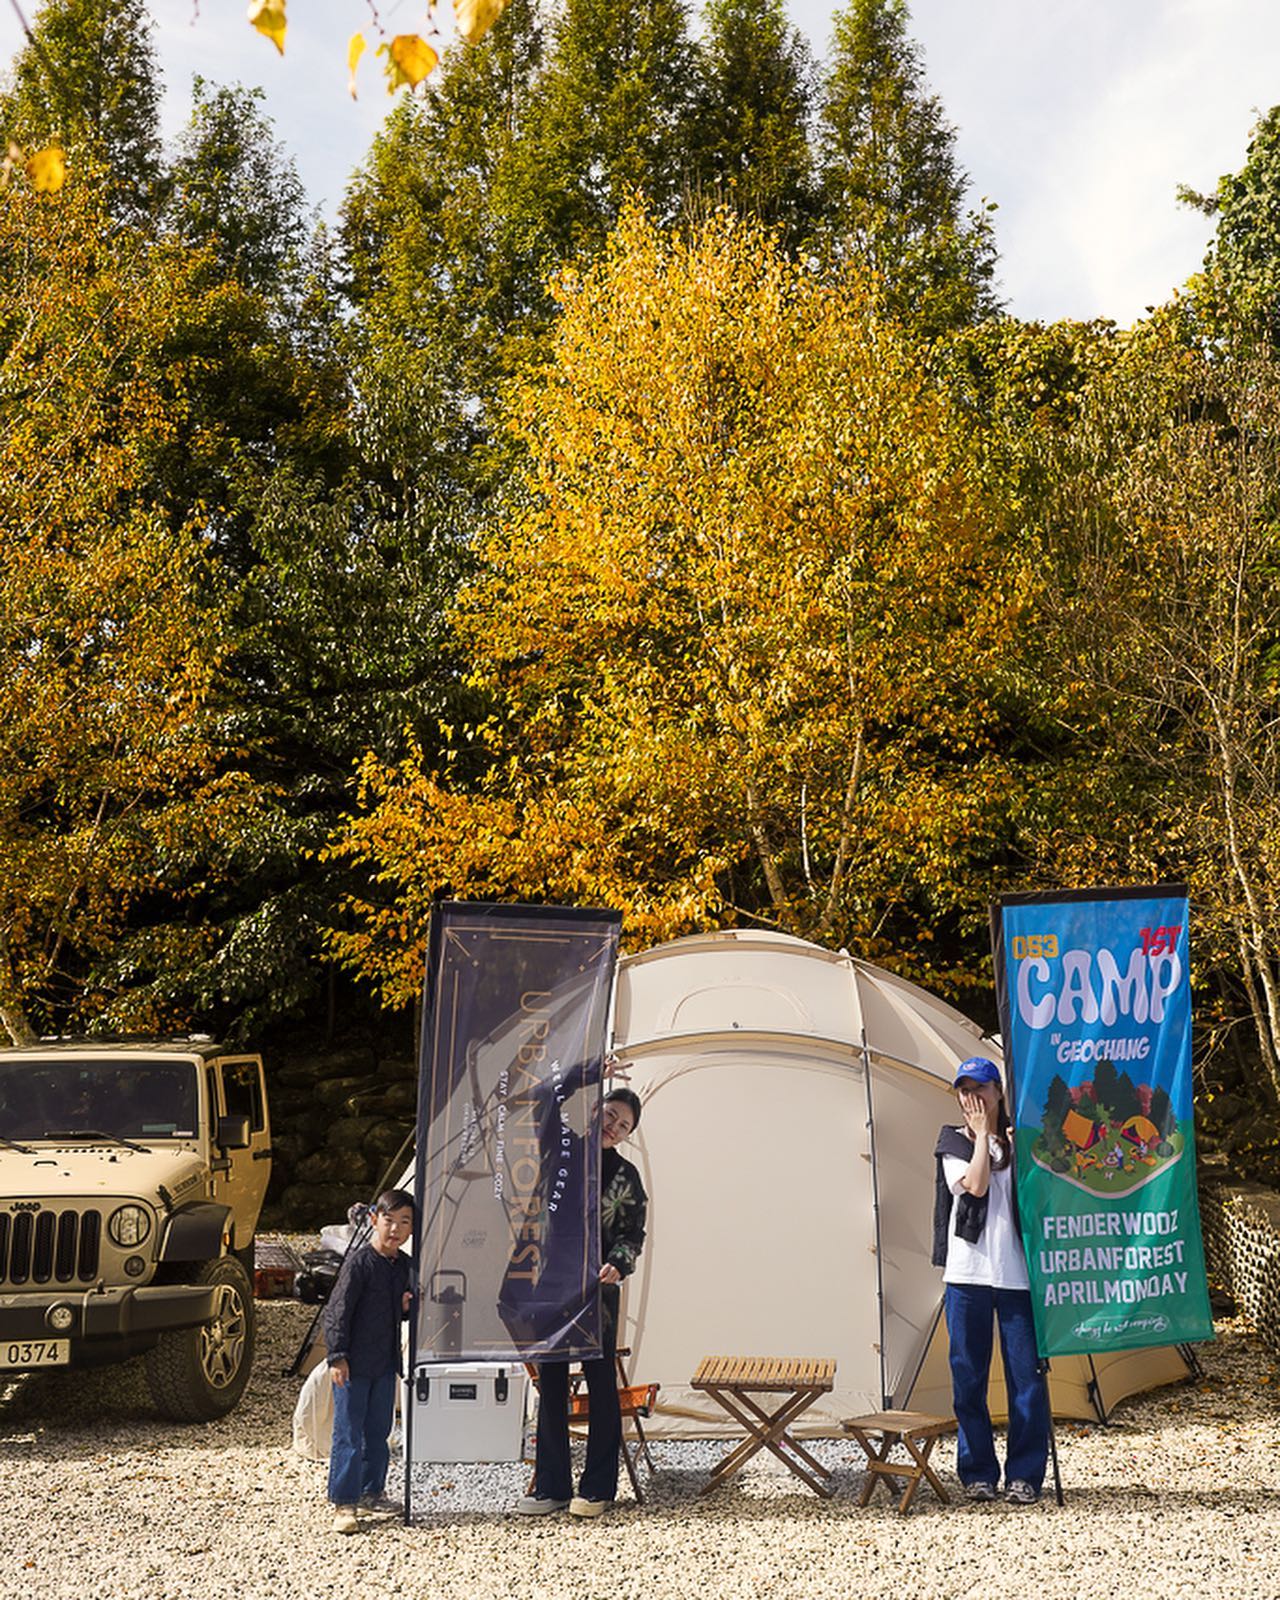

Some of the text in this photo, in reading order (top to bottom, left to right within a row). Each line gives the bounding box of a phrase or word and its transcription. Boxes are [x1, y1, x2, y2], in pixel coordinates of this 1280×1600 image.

[1012, 934, 1059, 960] 053
[1139, 926, 1182, 957] 1ST
[1017, 947, 1182, 1030] CAMP
[1051, 1033, 1062, 1046] IN
[1056, 1036, 1150, 1064] GEOCHANG
[493, 1070, 509, 1201] STAY CALM FINE COZY
[548, 1059, 571, 1212] WELL MADE GEAR
[9, 1202, 41, 1212] Jeep
[1042, 1209, 1179, 1240] FENDERWOOZ
[1039, 1241, 1186, 1274] URBANFOREST
[1044, 1271, 1188, 1307] APRILMONDAY
[8, 1342, 59, 1365] 0374
